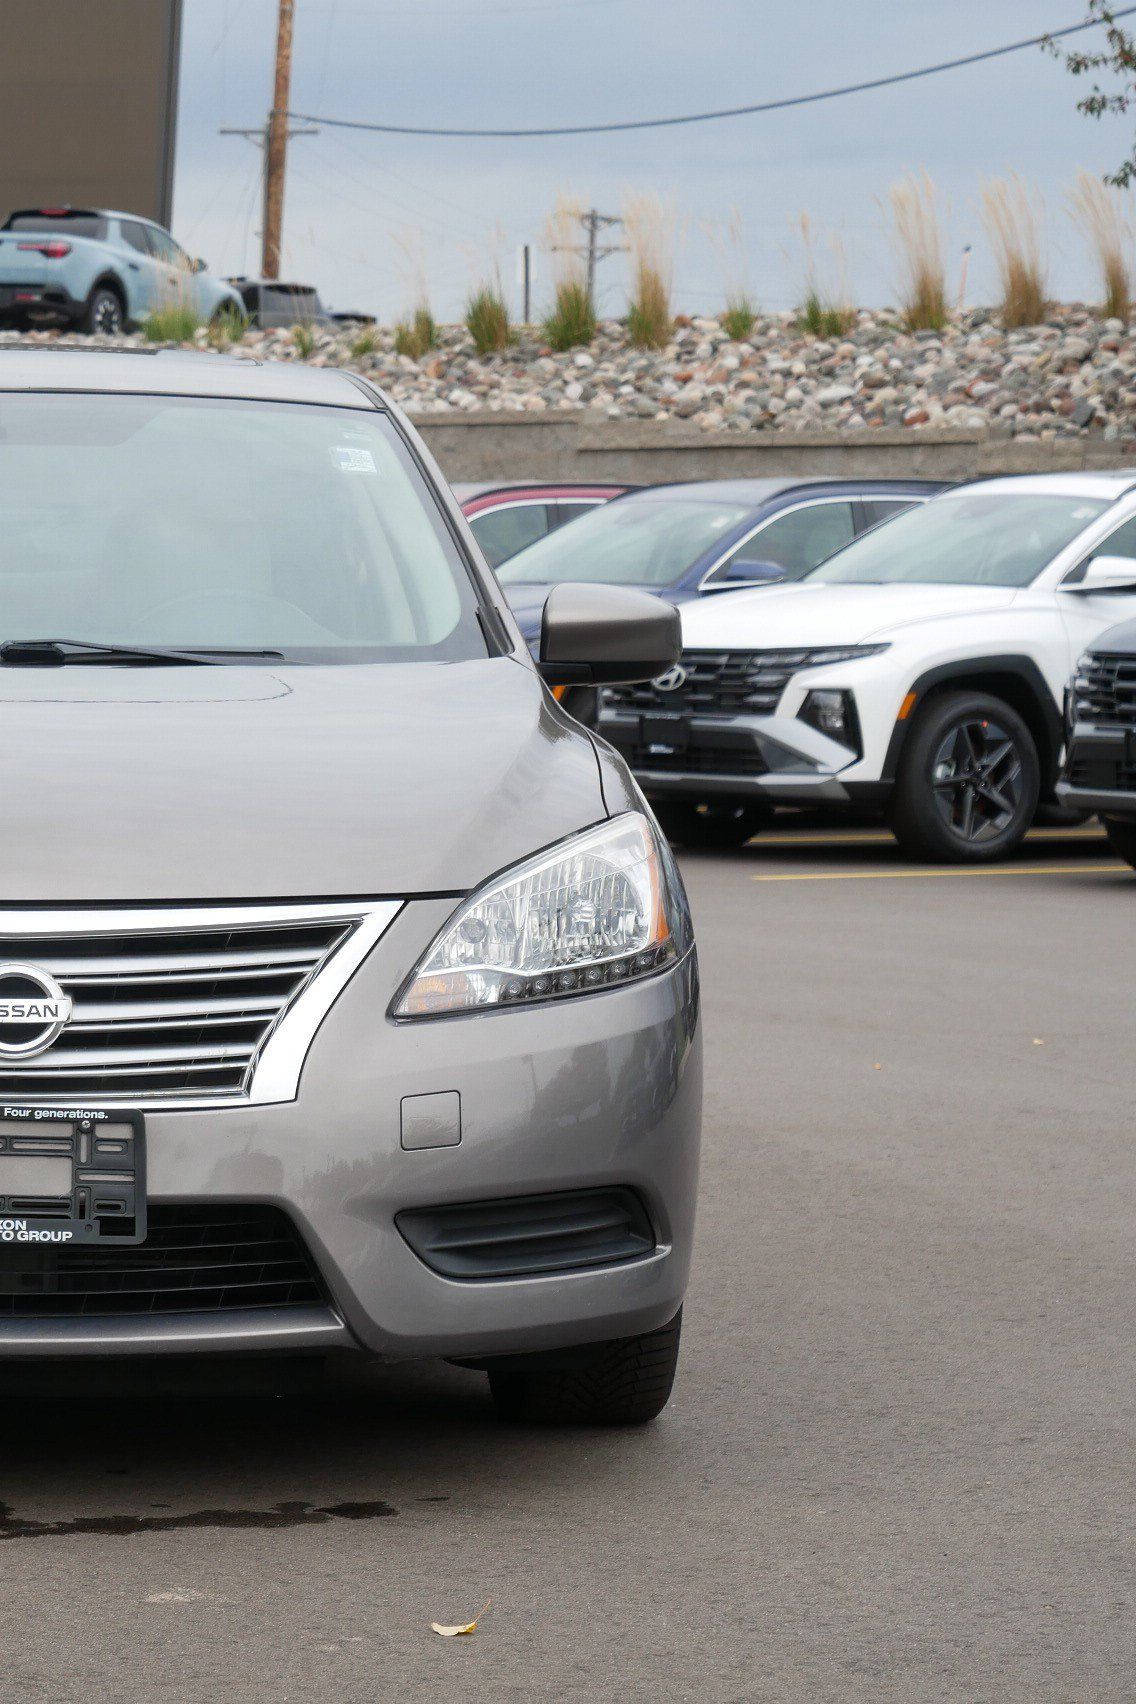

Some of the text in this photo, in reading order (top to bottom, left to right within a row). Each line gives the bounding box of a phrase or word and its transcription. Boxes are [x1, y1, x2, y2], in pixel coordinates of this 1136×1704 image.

[4, 1107, 32, 1117] Four
[34, 1109, 109, 1119] generations.
[16, 1230, 73, 1242] GROUP
